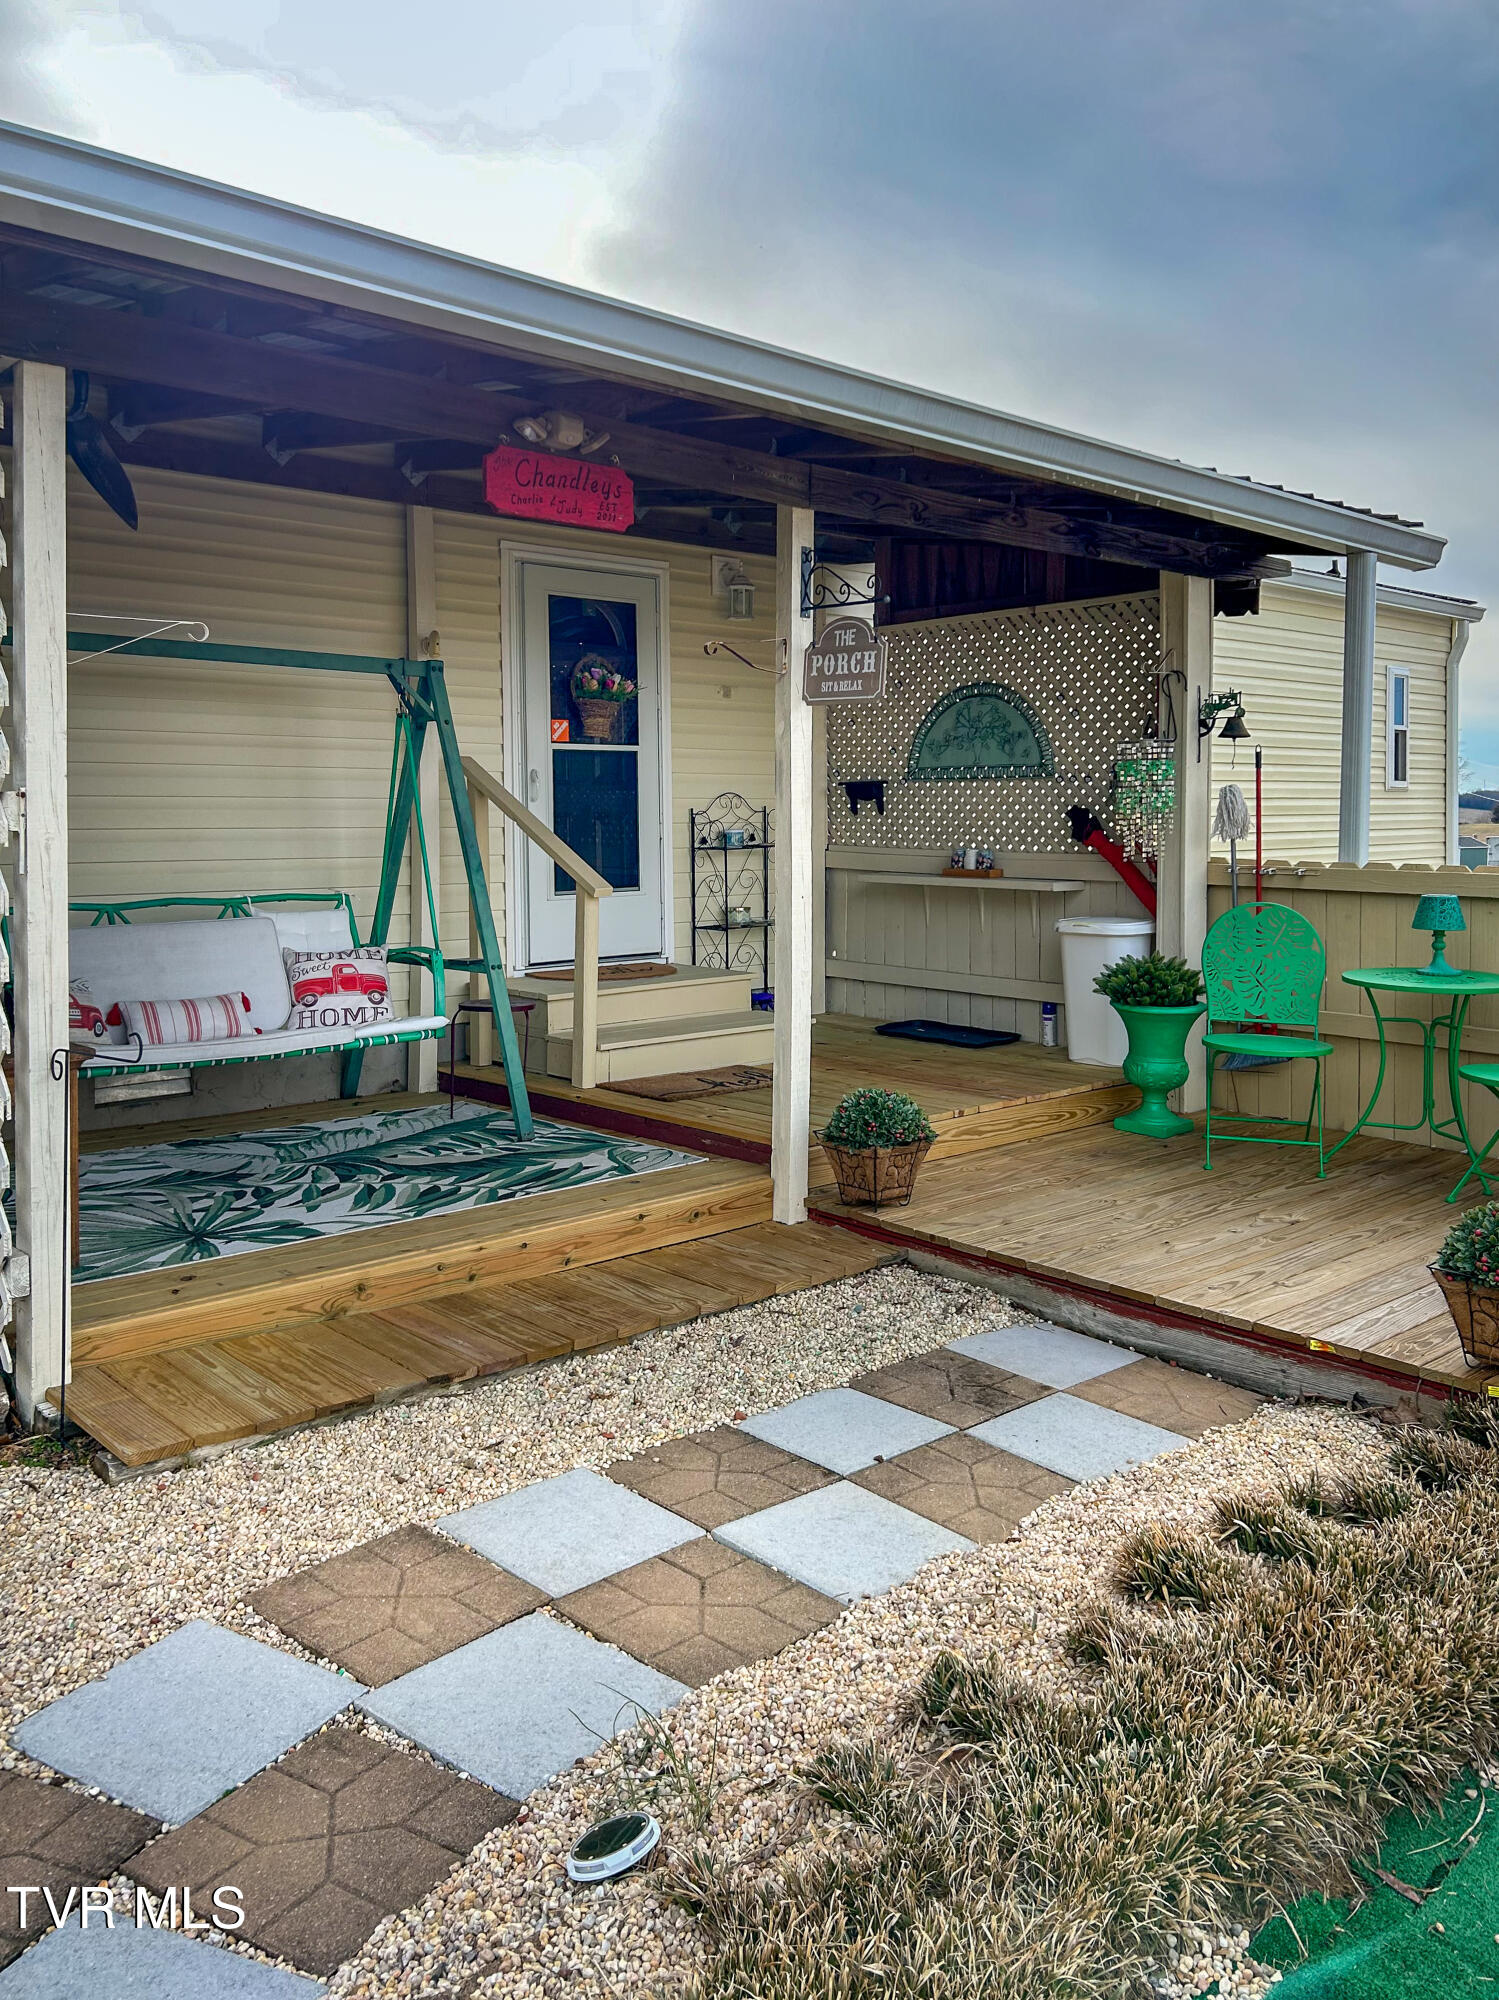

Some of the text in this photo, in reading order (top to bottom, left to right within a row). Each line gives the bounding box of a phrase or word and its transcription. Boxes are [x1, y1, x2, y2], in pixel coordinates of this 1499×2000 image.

[514, 458, 622, 500] Chandleys
[511, 493, 543, 505] Charlie
[556, 499, 583, 518] Judy
[599, 501, 617, 512] EST
[834, 628, 857, 647] THE
[810, 650, 877, 676] PORCH
[839, 679, 862, 691] RELAX
[291, 961, 331, 981] Sweet
[296, 1006, 389, 1029] HOME
